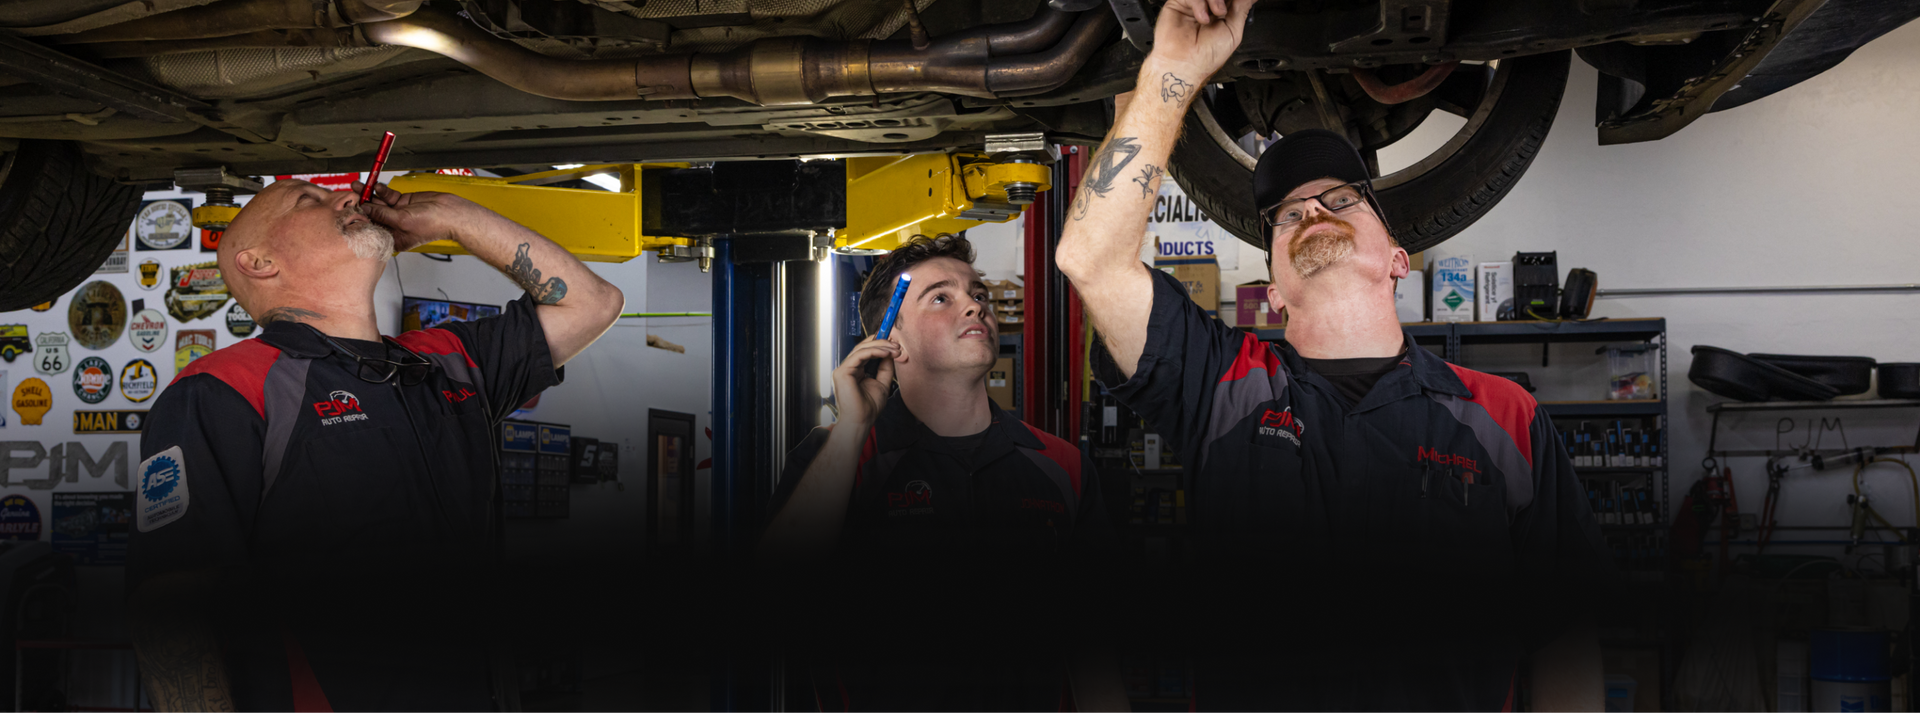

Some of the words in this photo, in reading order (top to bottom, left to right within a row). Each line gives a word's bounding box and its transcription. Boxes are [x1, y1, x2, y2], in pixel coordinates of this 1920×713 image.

[1147, 195, 1209, 223] CIALI
[1441, 272, 1467, 282] 134a
[131, 321, 165, 331] CHEVRON
[42, 355, 62, 371] 66
[122, 381, 154, 389] RICHFIELD
[21, 386, 43, 397] SHELL
[16, 399, 48, 408] GASOLINE
[313, 398, 363, 417] PJM
[321, 416, 342, 426] AUTO
[145, 467, 174, 491] ASE
[144, 495, 180, 513] CERTIFIED
